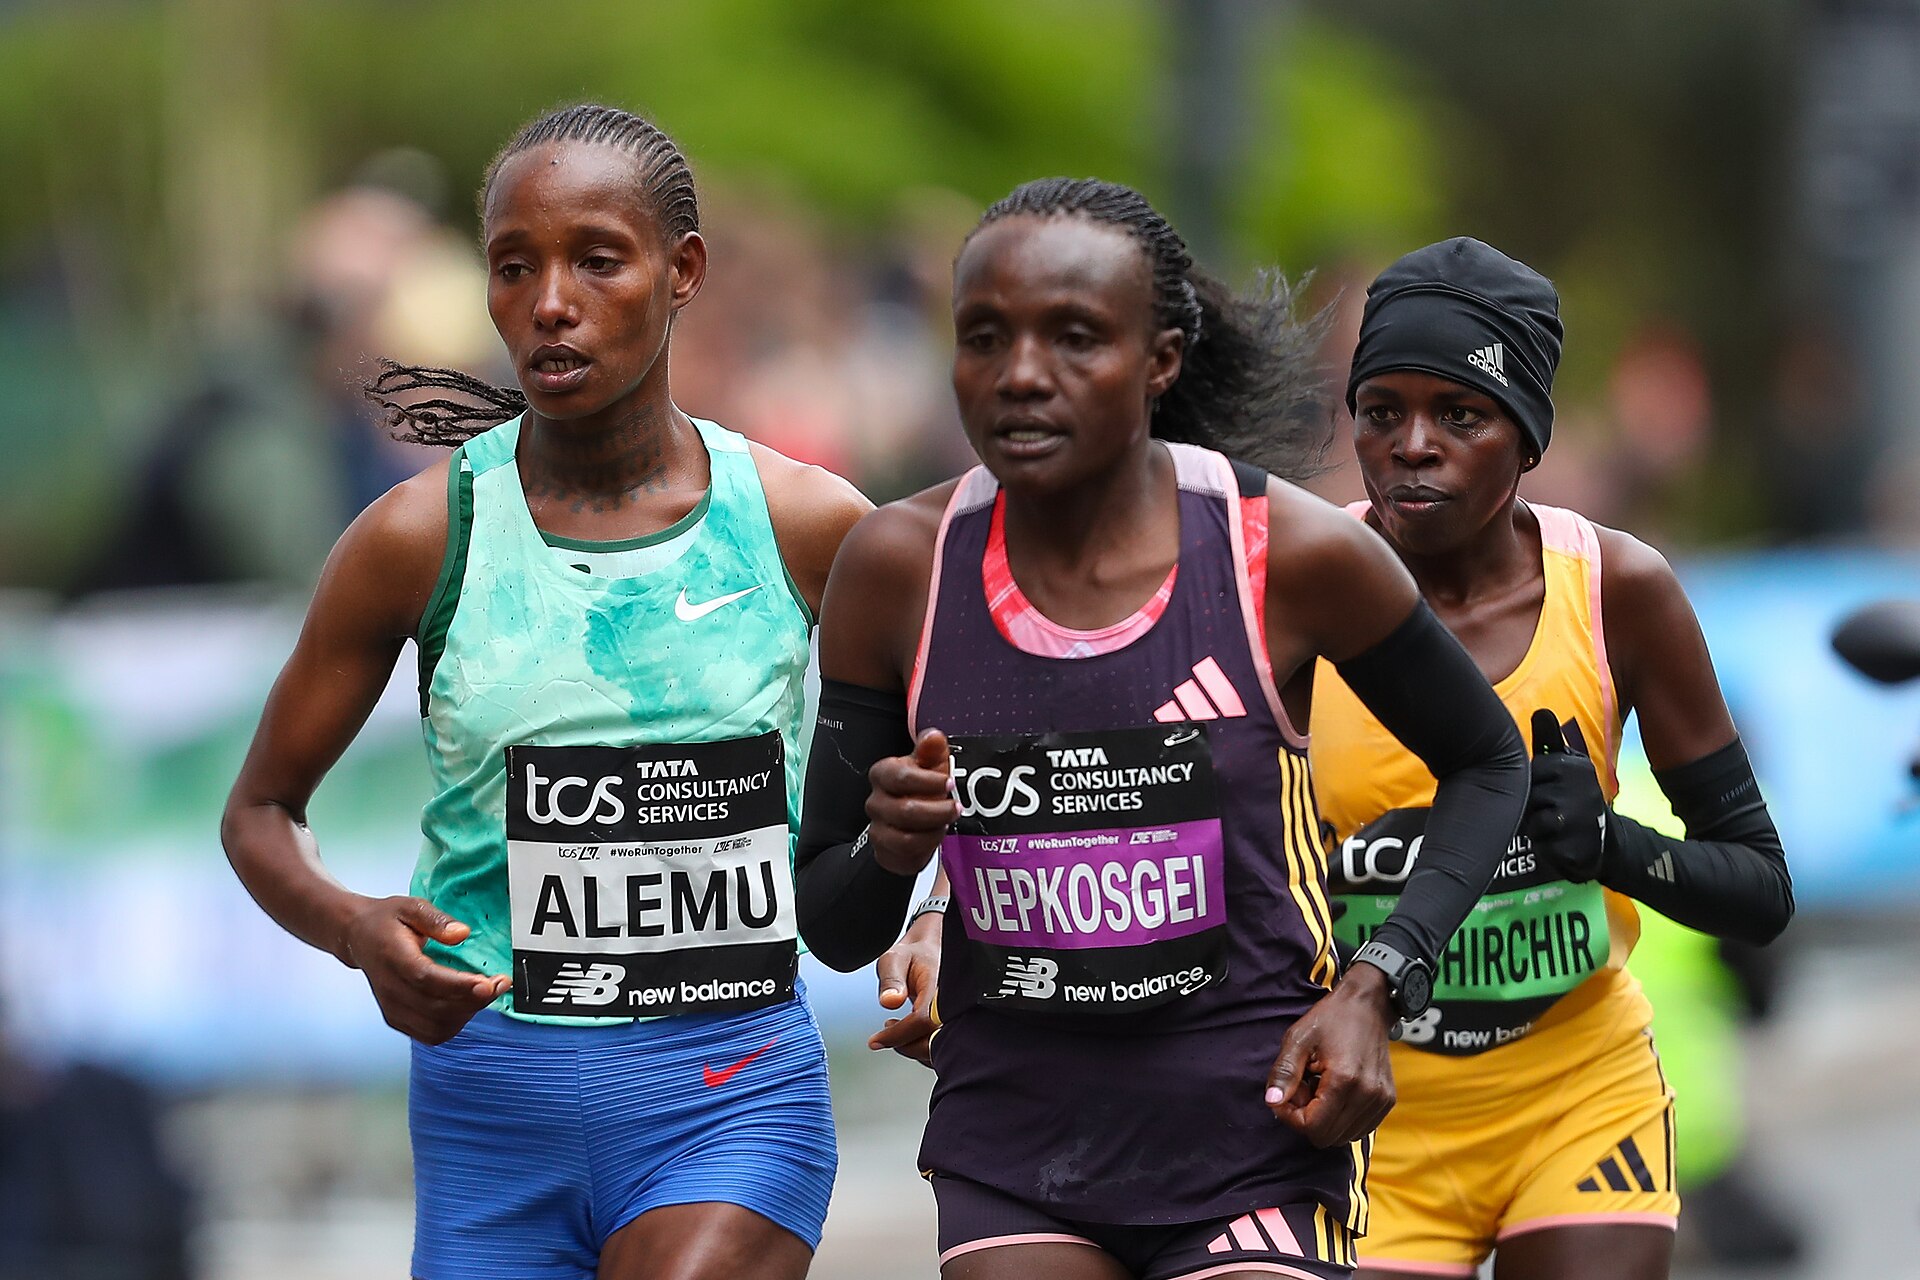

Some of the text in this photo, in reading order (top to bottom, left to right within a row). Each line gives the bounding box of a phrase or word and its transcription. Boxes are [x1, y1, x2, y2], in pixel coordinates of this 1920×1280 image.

[1467, 353, 1509, 388] adidas
[636, 759, 699, 779] TATA
[1046, 747, 1109, 768] TATA
[637, 770, 772, 802] CONSULTANCY
[949, 755, 1041, 817] tcs
[1050, 762, 1194, 791] CONSULTANCY
[526, 762, 626, 826] tcs
[1052, 791, 1144, 815] SERVICES
[637, 801, 730, 825] SERVICES
[610, 845, 703, 858] #WeRunTogether
[1027, 835, 1119, 850] #WeRunTogether
[1494, 853, 1536, 879] ICES
[530, 860, 778, 938] ALEMU
[969, 854, 1208, 934] JEPKOSGEI
[1358, 910, 1595, 987] HIRCHIR
[628, 977, 776, 1006] new balance
[1064, 966, 1205, 1002] new balance
[1443, 1025, 1491, 1049] new
